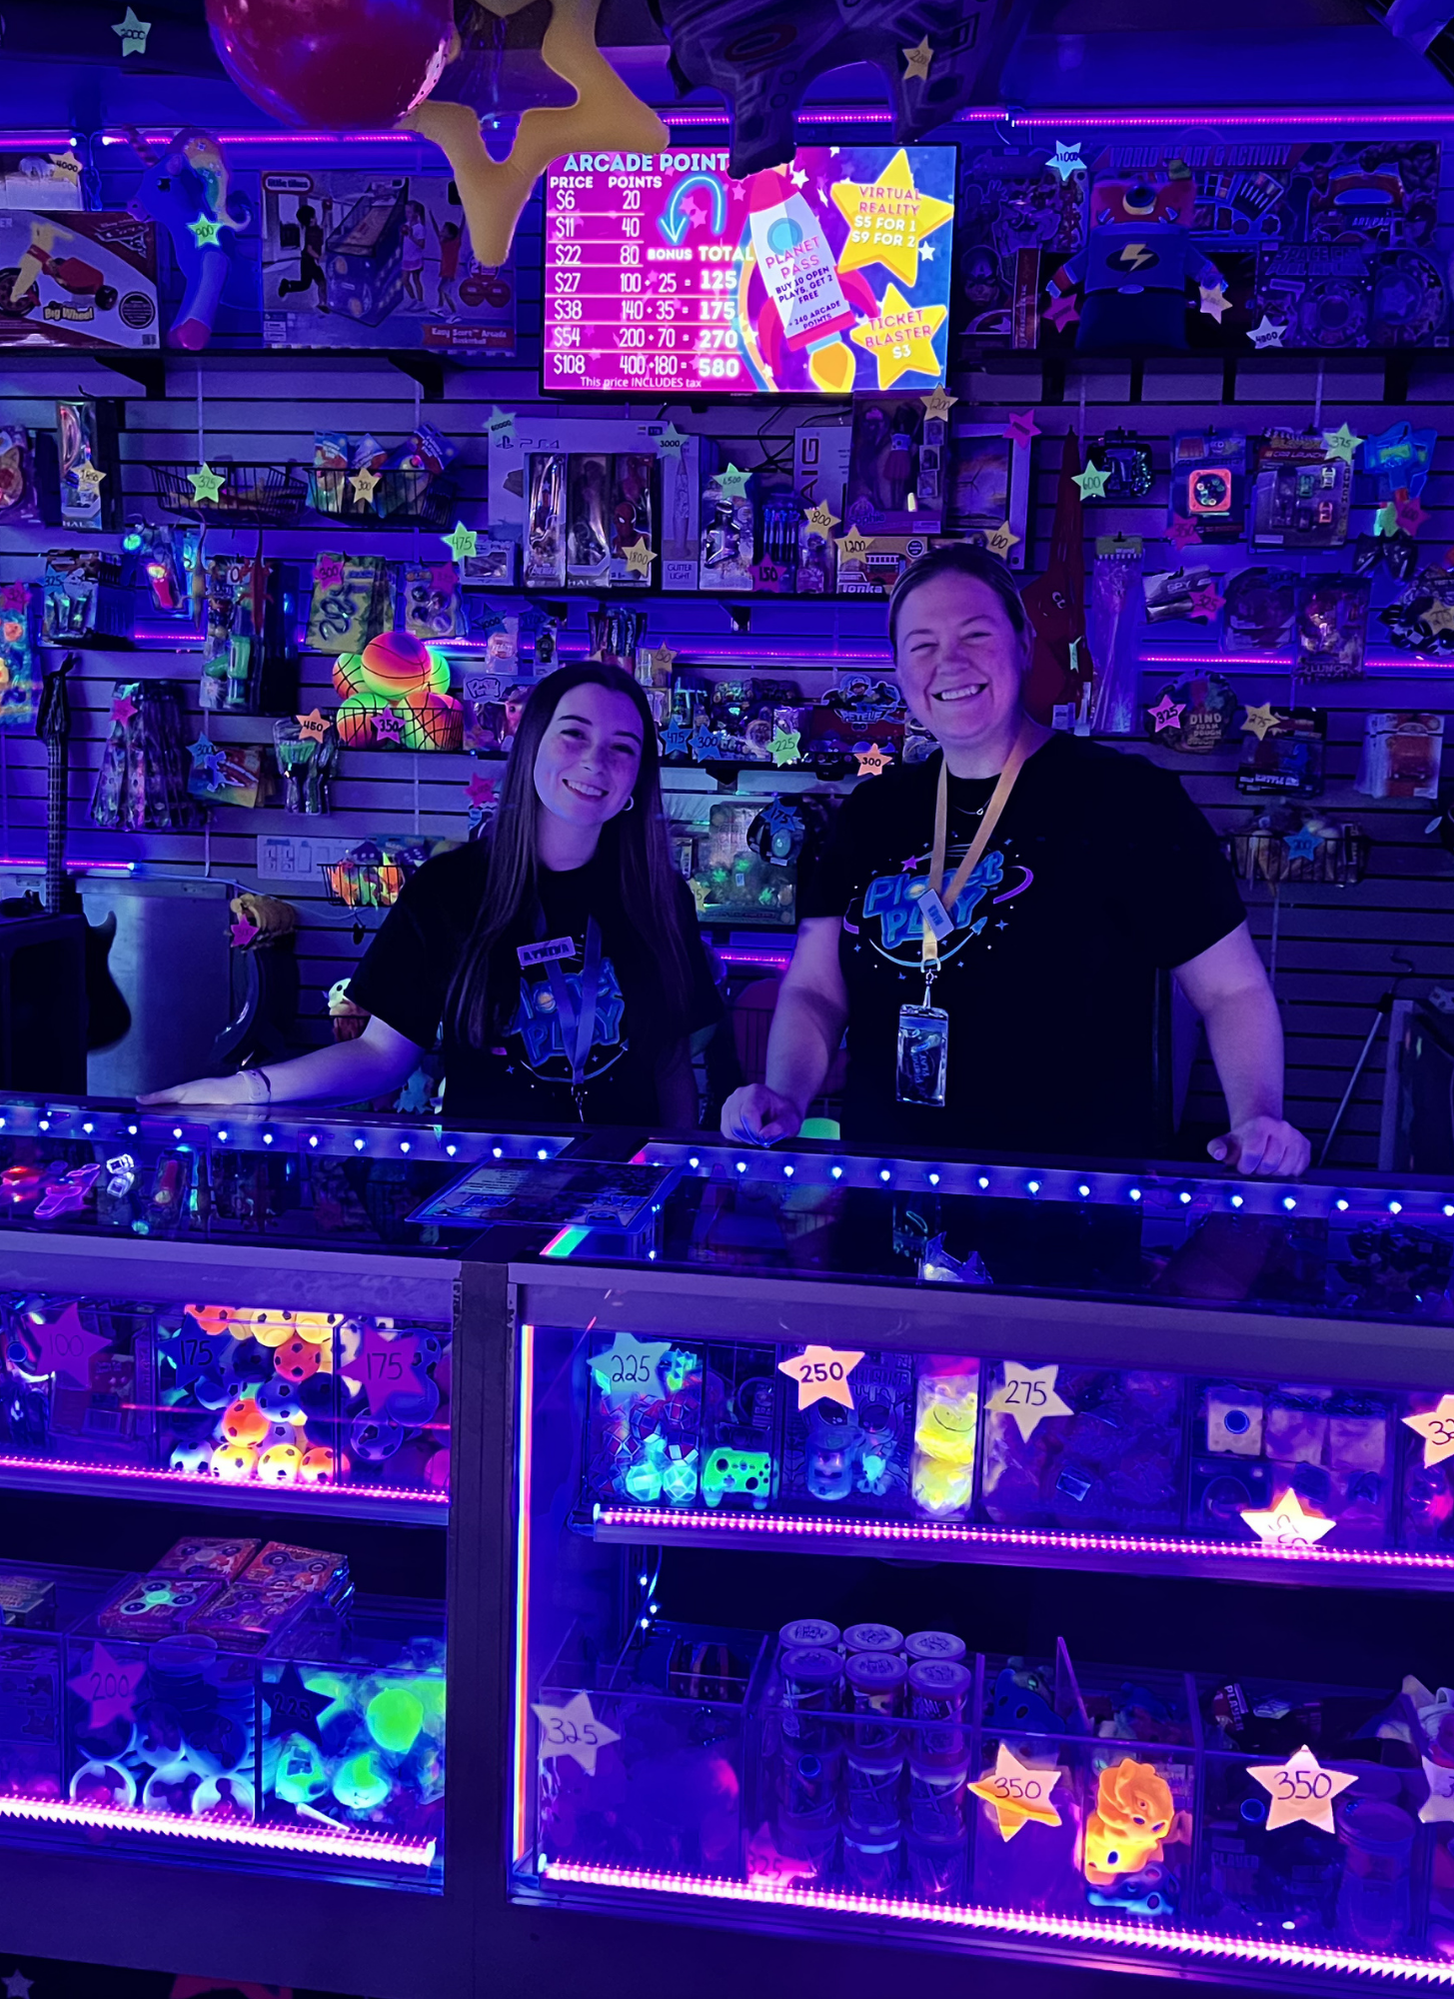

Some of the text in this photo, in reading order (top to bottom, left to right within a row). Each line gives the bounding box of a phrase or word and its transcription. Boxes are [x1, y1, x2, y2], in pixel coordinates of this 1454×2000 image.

[563, 153, 730, 172] ARCADE POINT
[1110, 147, 1158, 168] WORLD
[1184, 146, 1212, 167] ART
[1227, 145, 1292, 166] ACTIVITY
[57, 160, 79, 172] 4000
[550, 176, 662, 189] PRICE POINTS
[556, 189, 640, 210] $6 20
[859, 186, 922, 201] VIRTUAL
[859, 202, 920, 216] REALITY
[556, 217, 640, 238] $11 40
[854, 216, 916, 232] $5 FOR 1
[851, 230, 916, 248] $9 FOR 2
[555, 244, 640, 265] $22 80
[647, 246, 754, 262] BONUS TOTAL
[765, 236, 820, 269] PLANET
[781, 255, 820, 279] PASS
[555, 272, 581, 293] $27
[620, 273, 641, 293] 100
[658, 273, 677, 293] 25
[700, 270, 737, 290] 125
[775, 266, 830, 294] BUY 10 OPEN
[809, 277, 826, 289] GET
[827, 274, 833, 282] 2
[798, 290, 819, 304] FREE
[44, 307, 94, 321] Big Wheel
[554, 299, 582, 320] $38
[621, 300, 643, 320] 140
[656, 300, 675, 320] 35
[700, 301, 736, 320] 175
[810, 300, 841, 318] ARCADE
[803, 313, 832, 330] POINTS
[868, 309, 924, 331] TICKET
[554, 327, 581, 347] $54
[619, 328, 645, 348] 200
[658, 328, 676, 348] 70
[699, 330, 738, 349] 270
[865, 325, 933, 349] BLASTER
[893, 344, 911, 359] $3
[553, 355, 586, 375] $108
[619, 355, 646, 375] 400
[655, 355, 678, 375] 180
[699, 358, 740, 378] 580
[580, 377, 702, 389] This price INCLUDES tax
[520, 439, 560, 449] PS4
[659, 440, 681, 449] 3000
[1328, 436, 1352, 449] 375
[801, 438, 819, 508] AIG
[198, 475, 216, 490] 375
[357, 479, 371, 492] 300
[1341, 463, 1352, 503] AUNCH
[811, 511, 832, 527] 800
[452, 535, 473, 551] 475
[844, 539, 867, 553] 1200
[759, 567, 778, 582] 150
[841, 583, 883, 594] Tonka
[1156, 706, 1179, 723] 325
[1189, 712, 1223, 726] DINO
[303, 720, 324, 732] 450
[379, 718, 400, 732] 350
[667, 729, 687, 743] 475
[697, 735, 719, 749] 300
[774, 739, 797, 753] 225
[861, 755, 883, 768] 300
[880, 886, 988, 949] PLY
[521, 1003, 625, 1067] PLY
[50, 1333, 84, 1357] 100
[180, 1339, 214, 1366] 175
[367, 1352, 403, 1381] 175
[610, 1354, 651, 1383] 225
[800, 1361, 845, 1384] 250
[1004, 1380, 1048, 1407] 275
[90, 1672, 130, 1700] 200
[273, 1692, 311, 1720] 225
[547, 1717, 598, 1746] 325
[994, 1776, 1042, 1800] 350
[1273, 1770, 1333, 1801] 350
